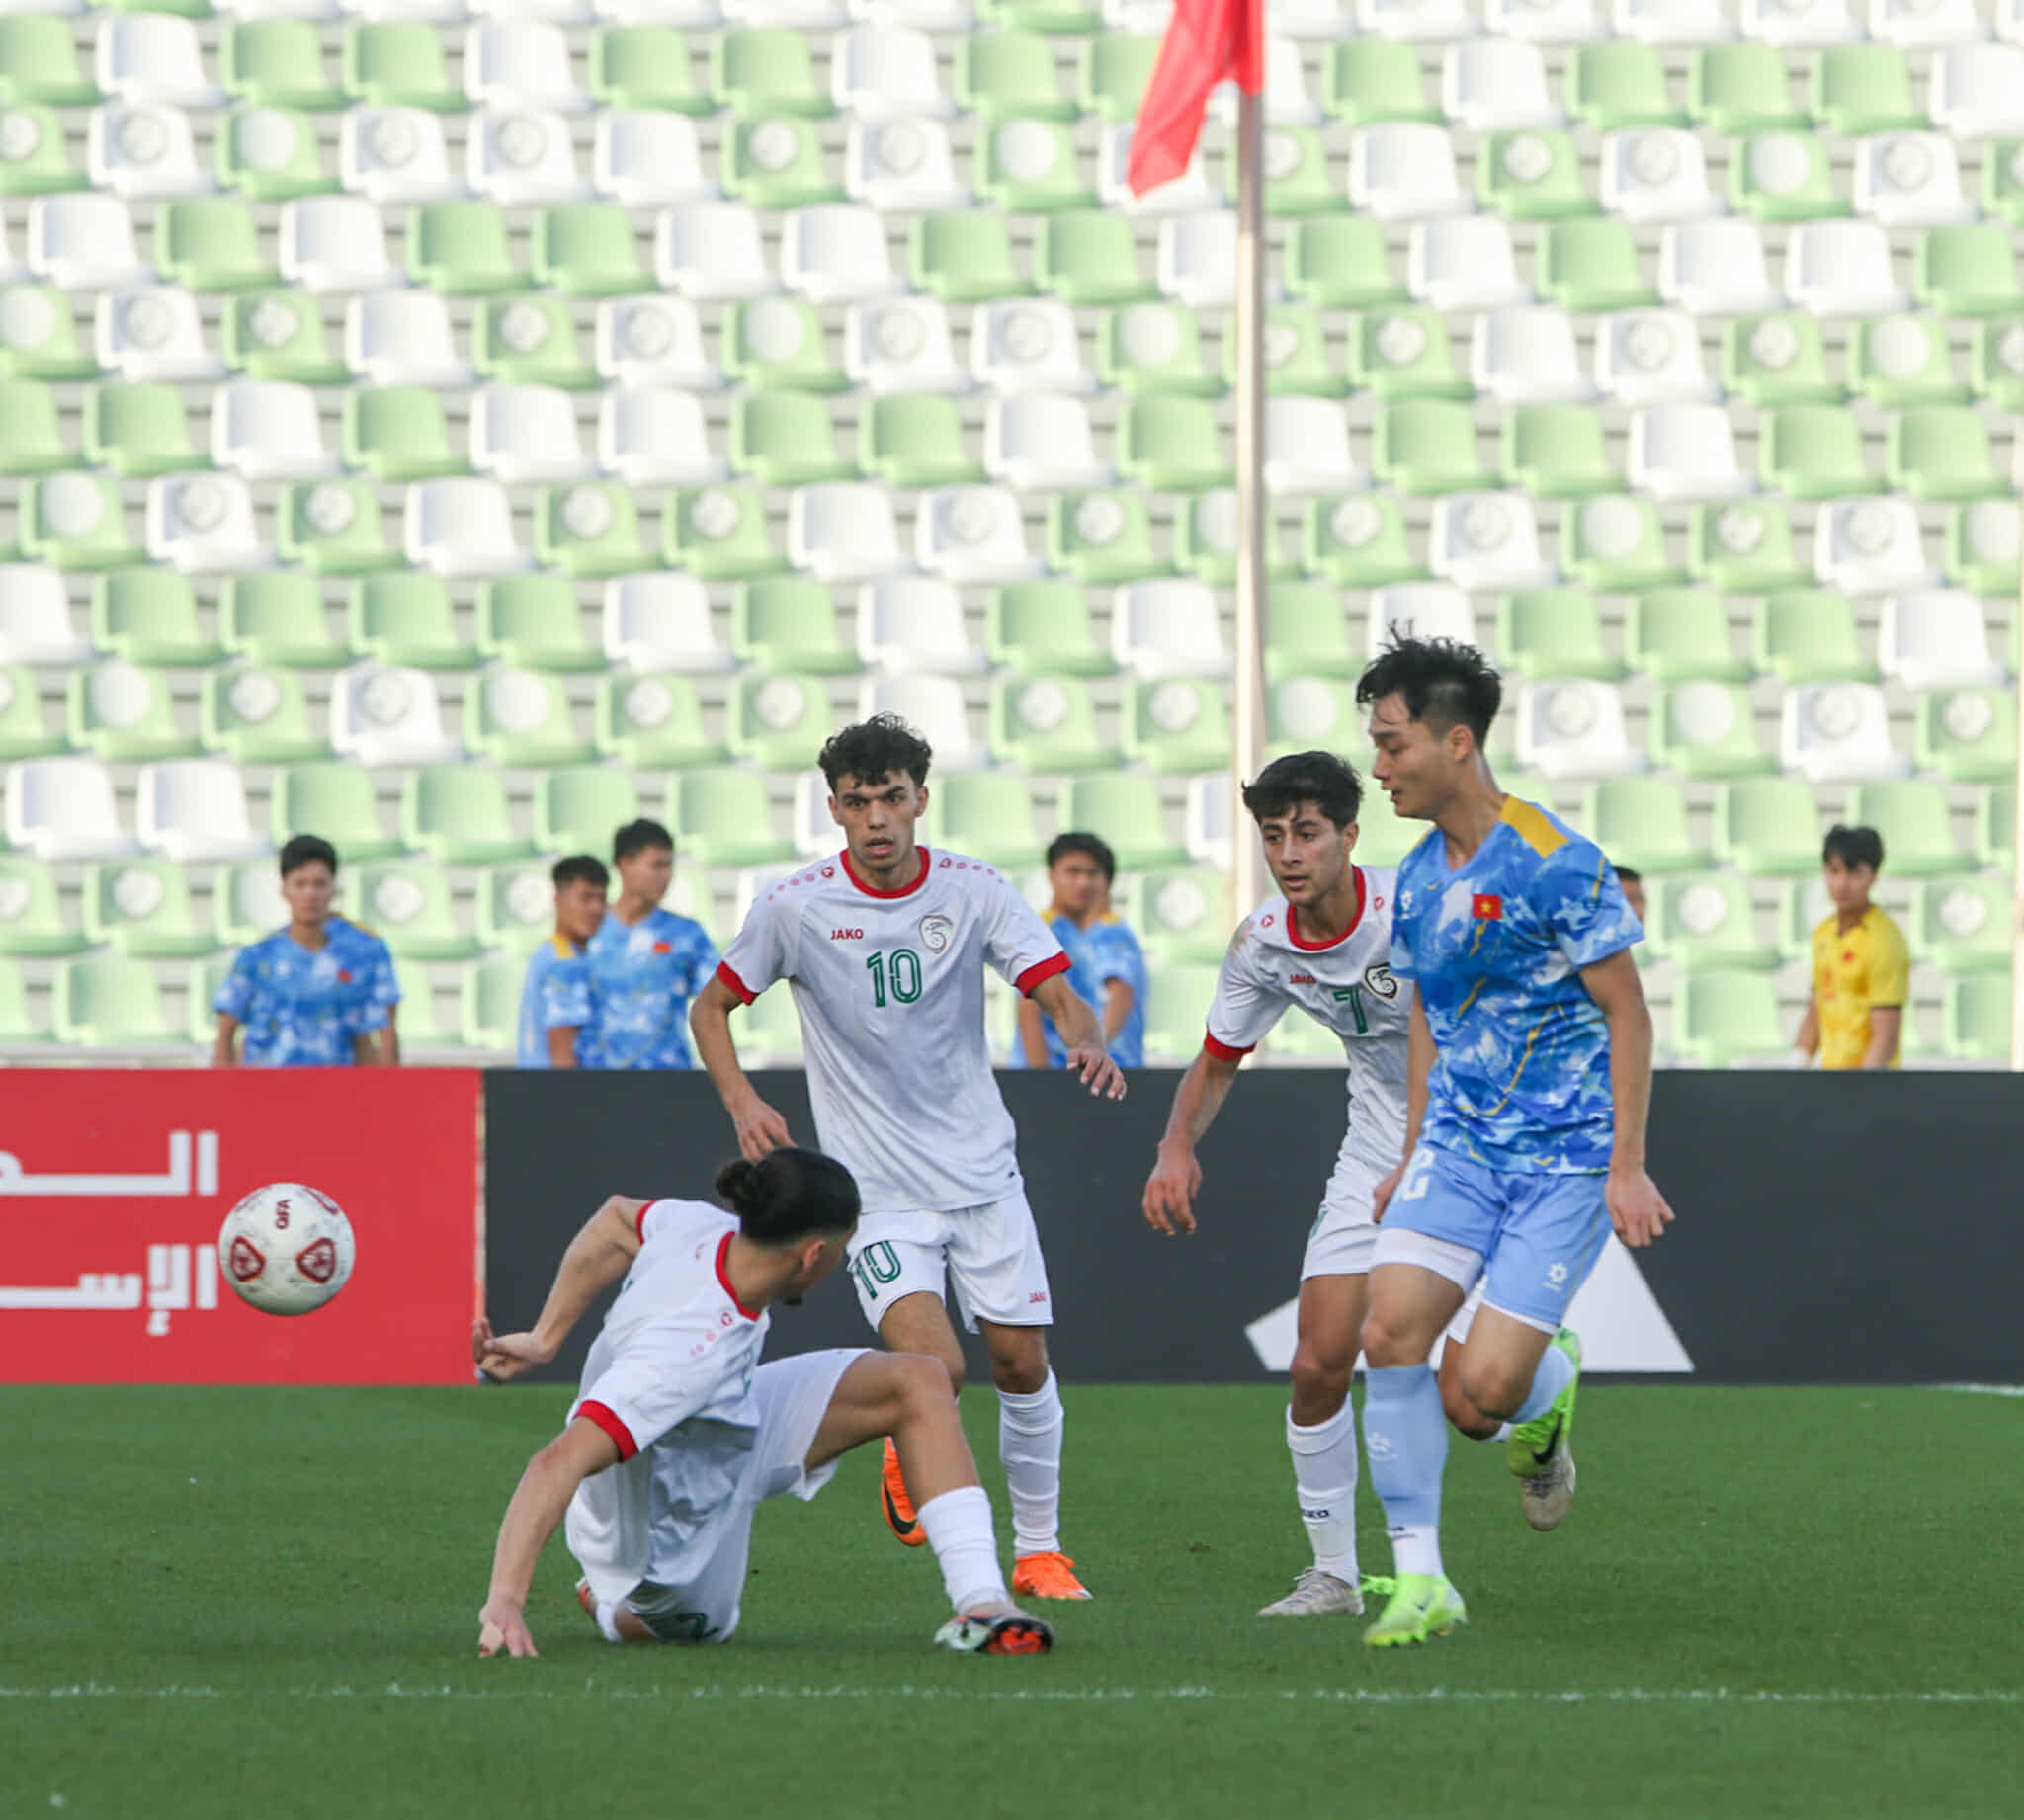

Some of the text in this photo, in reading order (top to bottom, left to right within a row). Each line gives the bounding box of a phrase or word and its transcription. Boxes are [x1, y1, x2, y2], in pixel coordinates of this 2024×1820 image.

[830, 928, 864, 940] JAKO
[866, 948, 923, 1008] 10
[1332, 987, 1369, 1034] 7
[856, 1240, 902, 1300] 10
